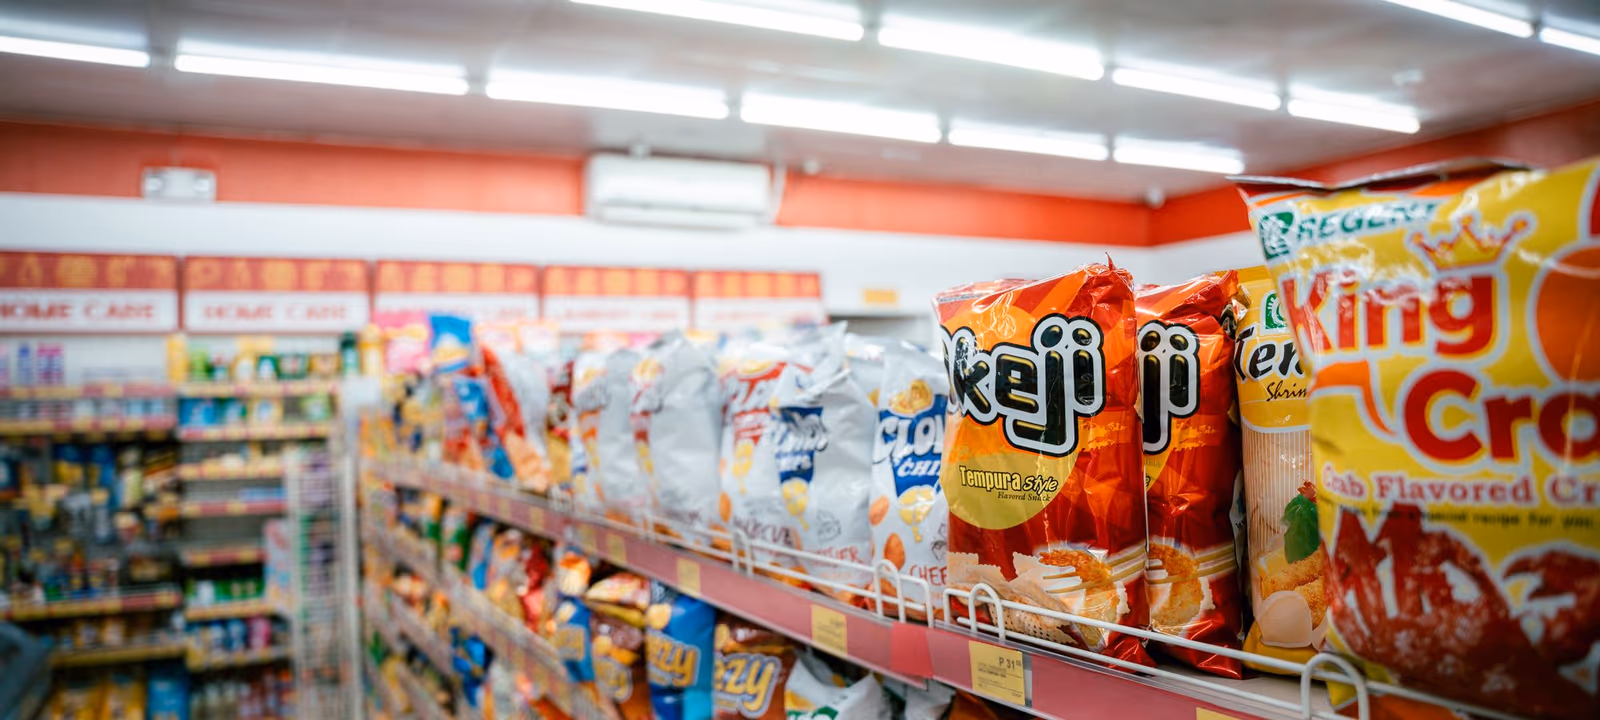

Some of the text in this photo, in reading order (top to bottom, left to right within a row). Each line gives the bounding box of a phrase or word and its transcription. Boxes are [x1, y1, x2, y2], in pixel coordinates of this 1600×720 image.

[1280, 270, 1498, 357] King
[1403, 368, 1600, 466] Cro
[896, 459, 941, 477] CHI
[959, 465, 1059, 496] Tempura Style
[1323, 464, 1366, 499] Crab
[1374, 474, 1533, 503] Flavored
[997, 491, 1051, 502] Flavored Snack
